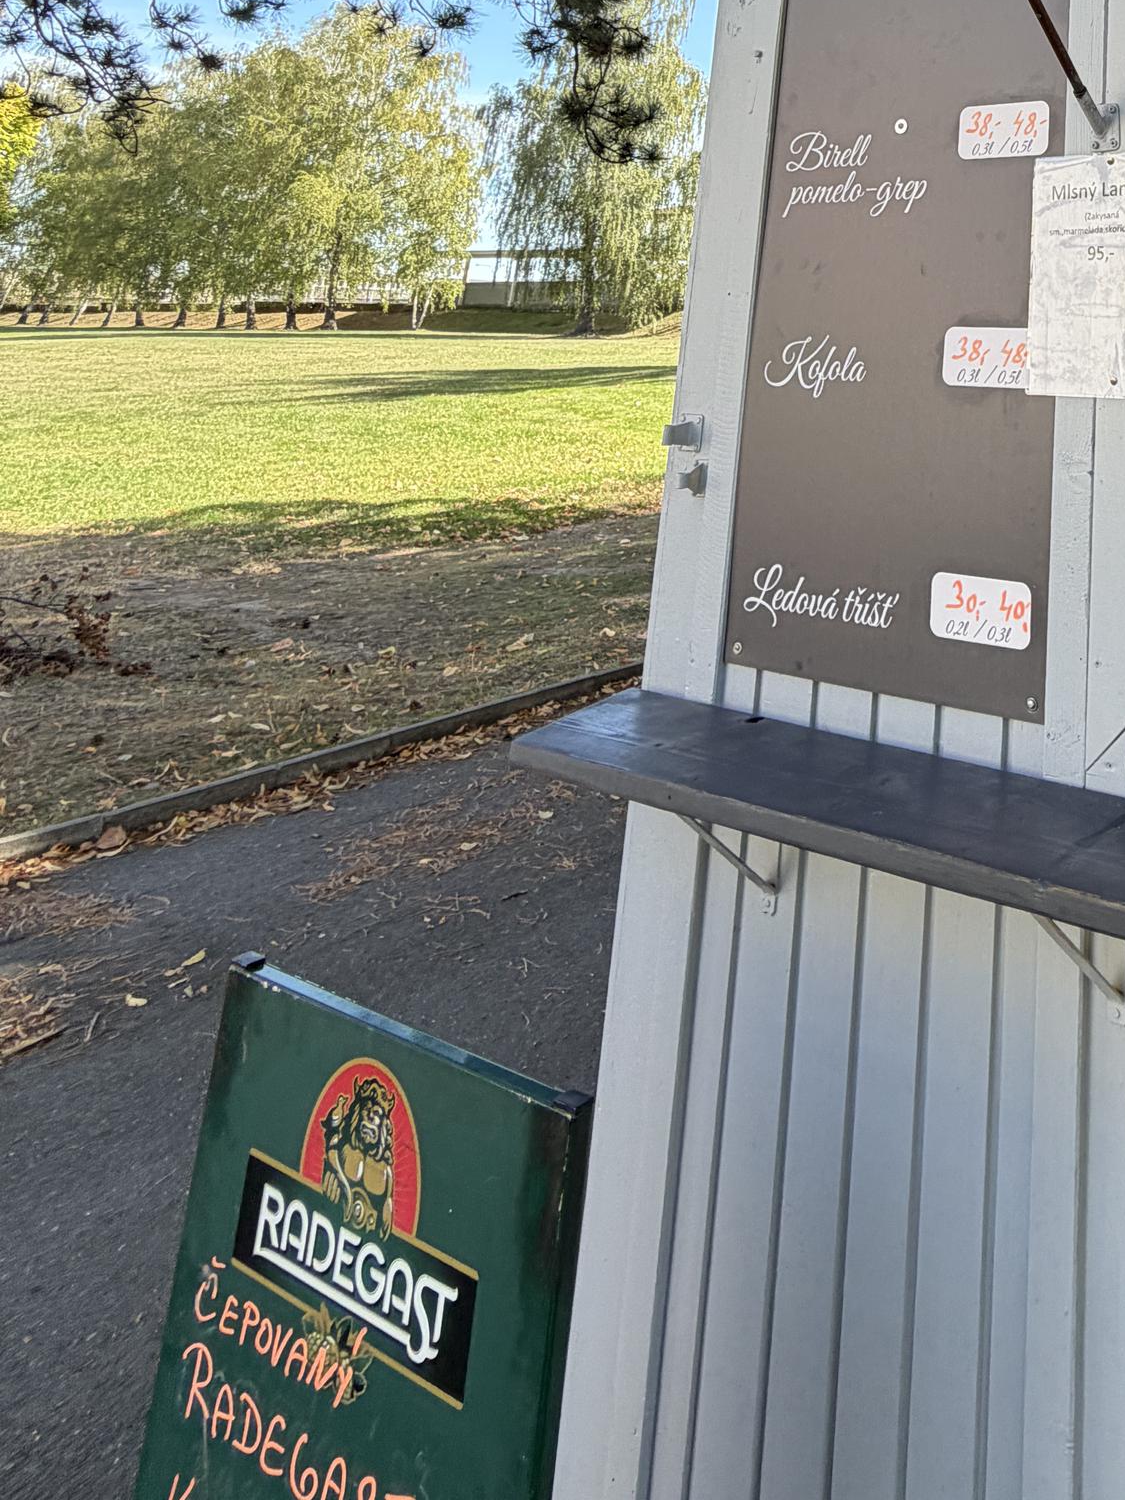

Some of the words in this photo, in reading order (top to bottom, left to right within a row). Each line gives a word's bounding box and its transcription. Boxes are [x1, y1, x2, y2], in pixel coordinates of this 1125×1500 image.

[785, 130, 873, 172] Birell
[781, 170, 928, 219] pomelo-grep
[1051, 182, 1098, 201] Mlsný
[1087, 245, 1115, 262] 95,-
[764, 334, 867, 398] Kofola
[743, 563, 841, 628] Ledová
[842, 586, 900, 629] tříšť
[253, 1182, 458, 1364] RADEGAST
[194, 1255, 368, 1409] ČEPOVANÝ
[182, 1342, 417, 1500] RADEGA
